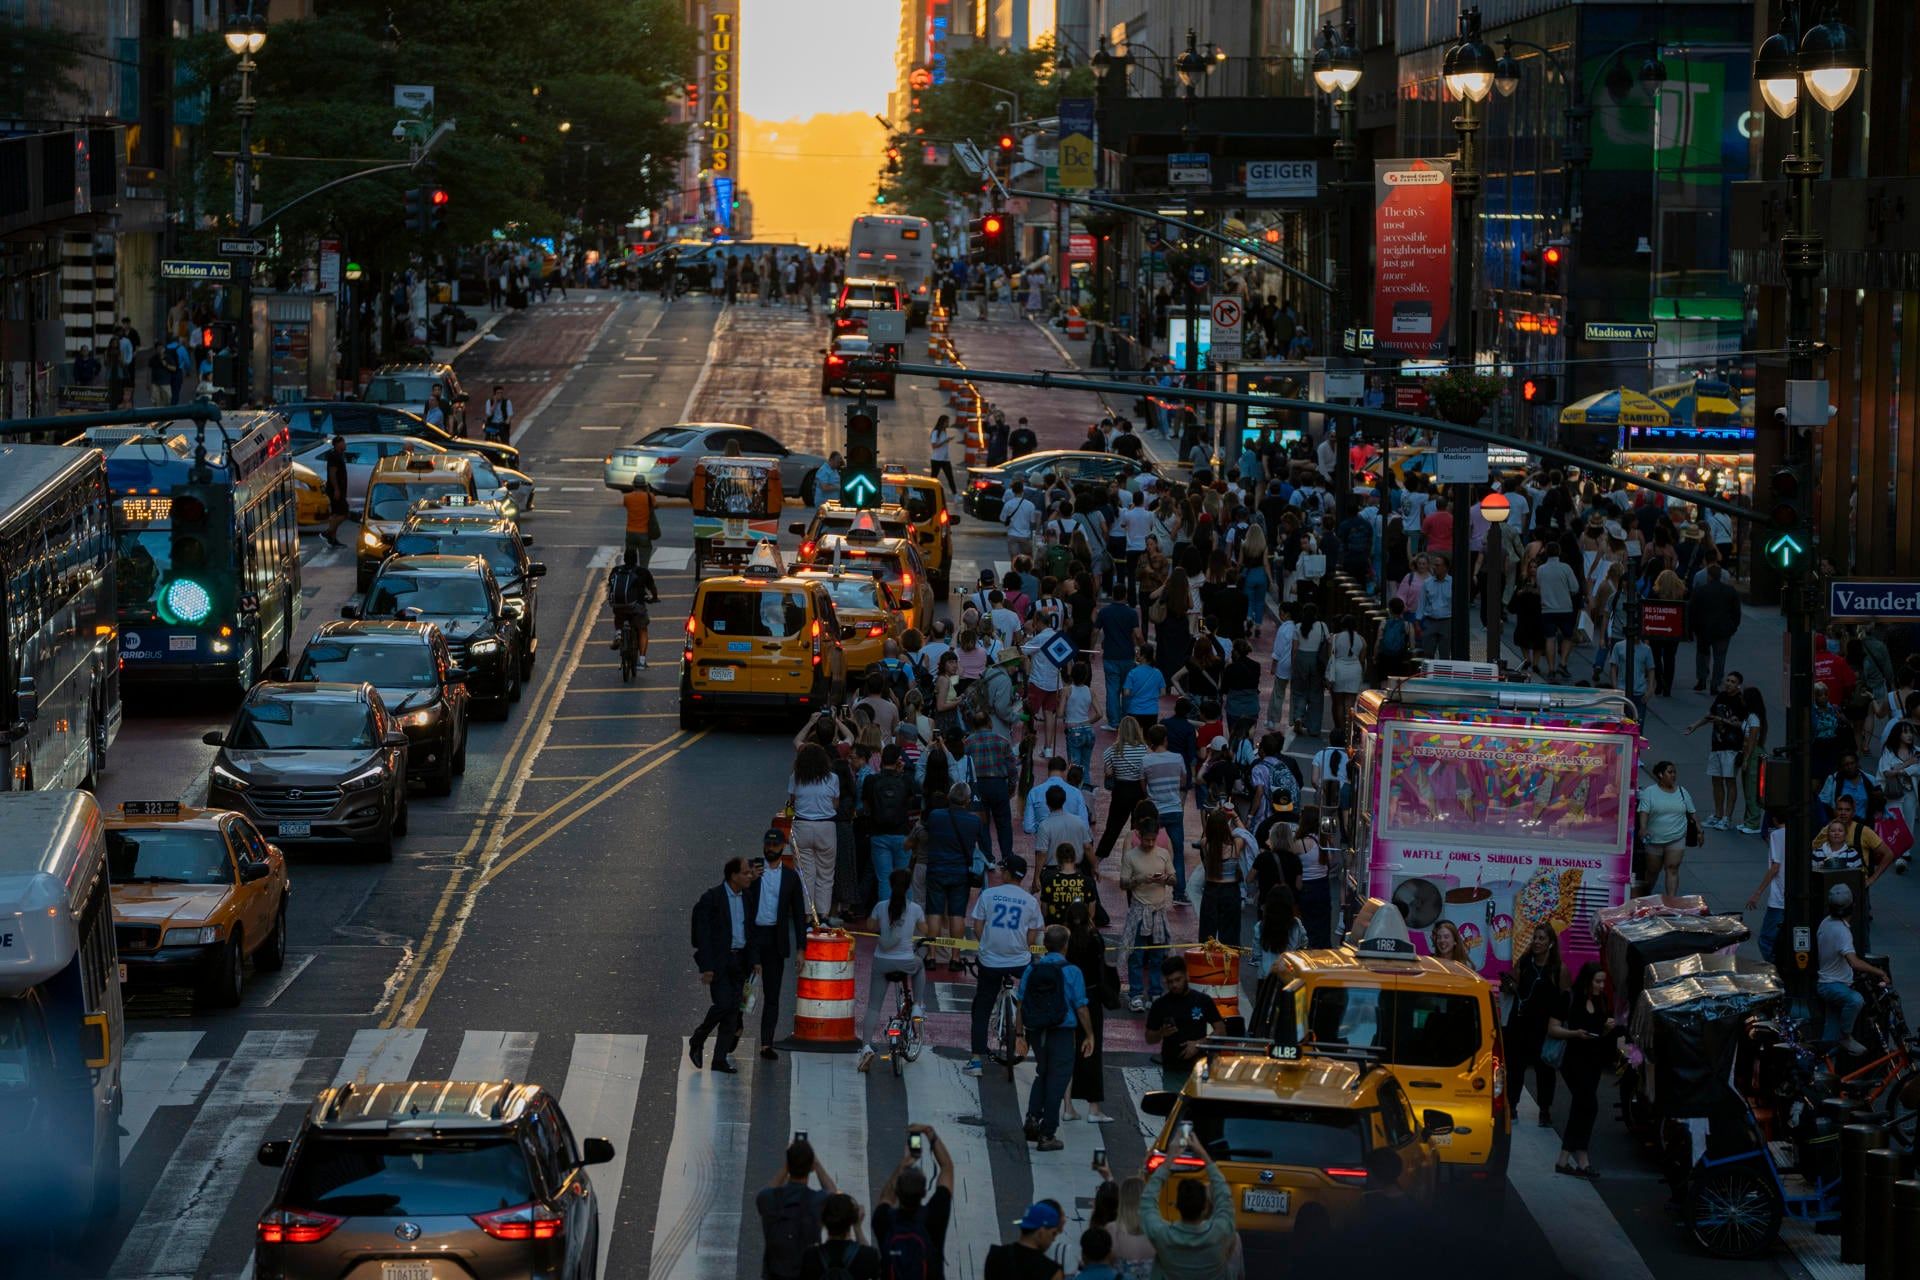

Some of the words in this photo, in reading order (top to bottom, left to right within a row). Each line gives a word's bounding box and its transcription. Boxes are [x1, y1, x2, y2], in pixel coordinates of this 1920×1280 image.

[712, 14, 731, 170] TUSSAUDS
[1250, 164, 1313, 179] GEIGER
[1384, 207, 1400, 217] The
[1402, 206, 1425, 219] city's
[1383, 221, 1405, 230] most
[1383, 231, 1428, 242] accessible
[1383, 244, 1447, 256] neighborhood
[163, 263, 208, 276] Madison
[209, 264, 230, 276] Ave
[1383, 259, 1399, 268] just
[1400, 259, 1415, 269] got
[1382, 273, 1406, 281] more
[1382, 283, 1430, 293] accessible.
[1587, 326, 1632, 339] Madison
[1633, 327, 1654, 339] Ave
[1379, 341, 1418, 350] MIDTOWN
[1422, 342, 1443, 350] EAST
[122, 499, 148, 510] EAST
[1652, 607, 1678, 615] STANDING
[1644, 613, 1666, 622] Anytime
[144, 802, 162, 814] 323
[1402, 849, 1443, 860] WAFFLE
[1449, 852, 1481, 862] CONES
[1487, 854, 1533, 865] SUNDAES
[1538, 857, 1603, 869] MILKSHAKES
[1053, 879, 1085, 887] LOOK
[991, 903, 1022, 930] 23
[0, 934, 13, 947] E
[1376, 938, 1396, 951] 1R62
